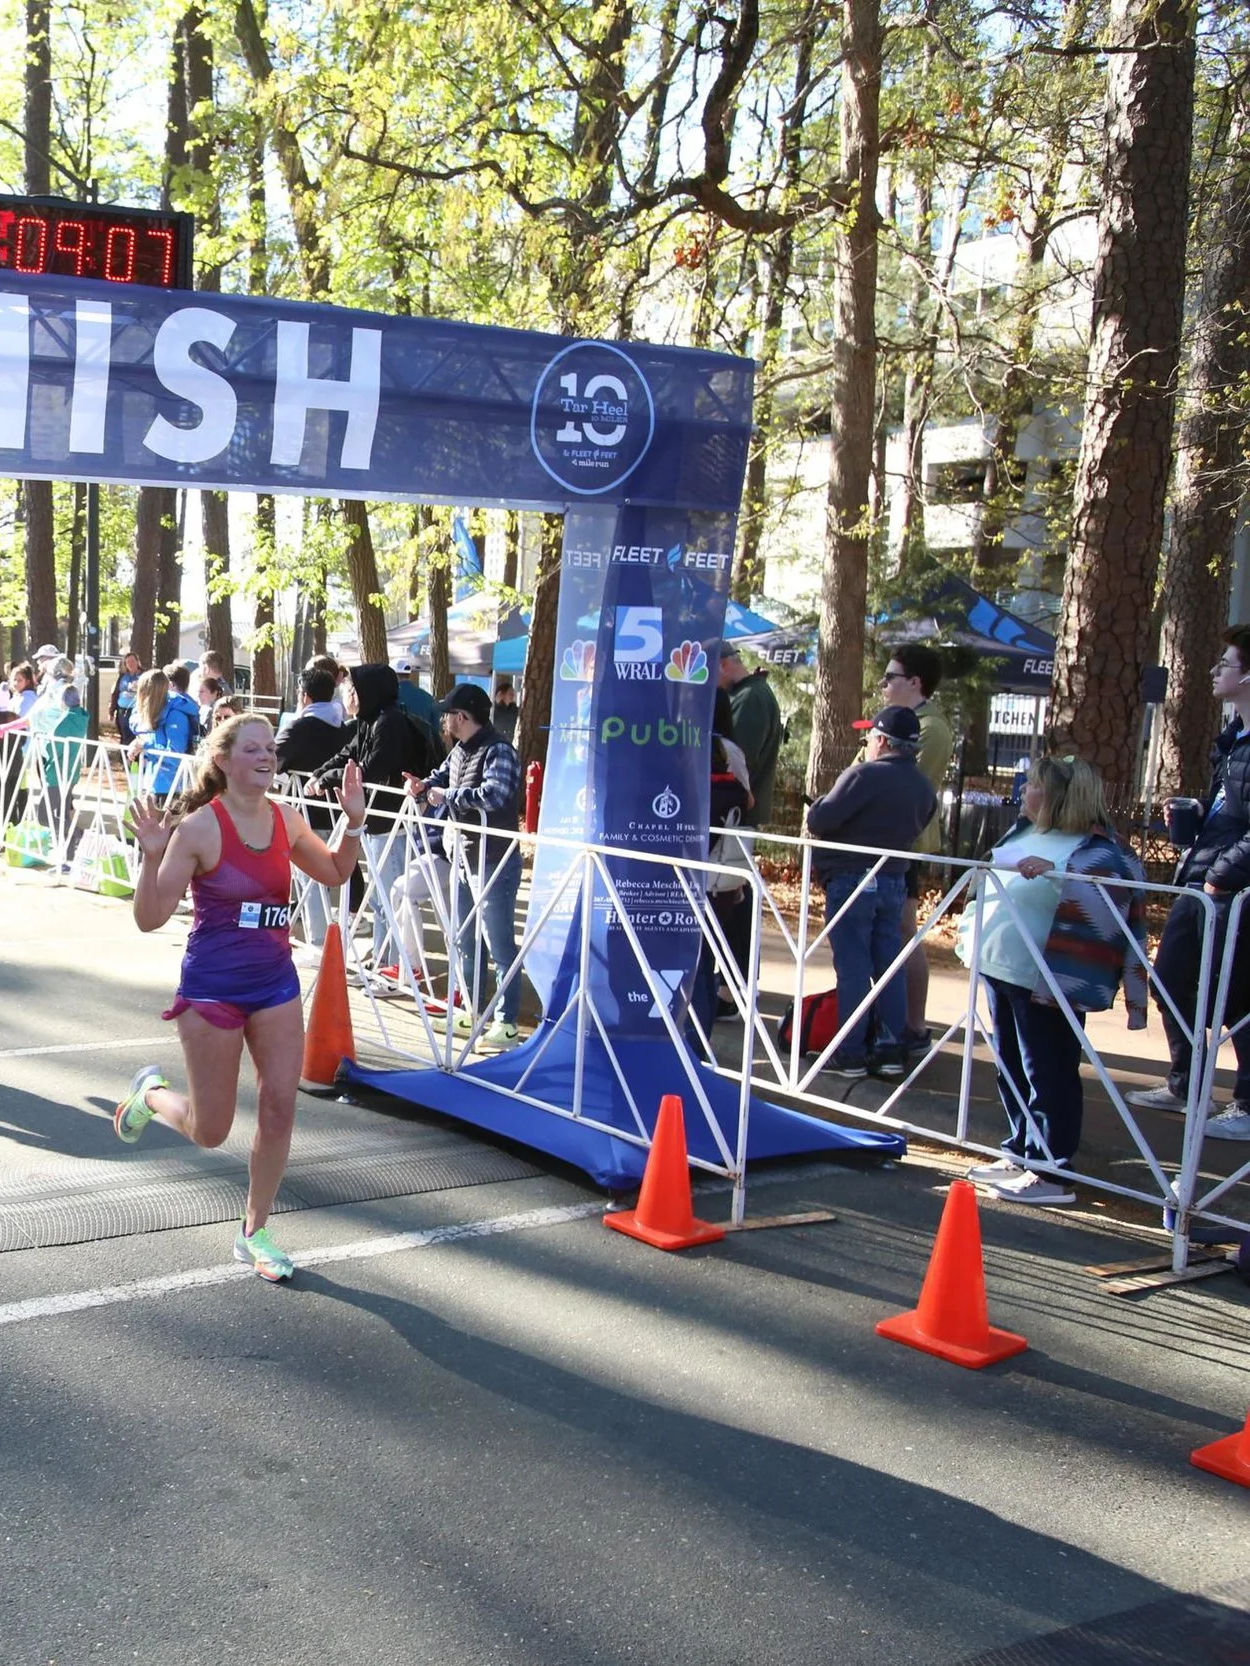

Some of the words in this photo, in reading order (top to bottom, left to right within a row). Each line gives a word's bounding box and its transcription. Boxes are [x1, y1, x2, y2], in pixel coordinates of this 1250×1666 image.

[556, 372, 629, 447] 10
[560, 398, 588, 413] Tar
[591, 400, 628, 416] Heel
[571, 449, 592, 458] FLEET
[600, 451, 618, 459] FEET
[578, 459, 595, 467] mile
[611, 545, 664, 564] FLEET
[684, 551, 730, 570] FEET
[614, 605, 664, 662] 5
[758, 649, 801, 664] FLEET
[614, 662, 663, 681] WRAL
[1023, 658, 1054, 675] FLEE
[990, 710, 1036, 726] TCHEN
[601, 715, 702, 748] Publix
[628, 821, 670, 831] CHAPEL
[599, 832, 630, 841] FAMILY
[631, 833, 638, 841] &
[640, 833, 684, 843] COSMETIC
[615, 879, 650, 889] Rebecca
[652, 880, 683, 889] Meschi
[627, 991, 649, 1002] the
